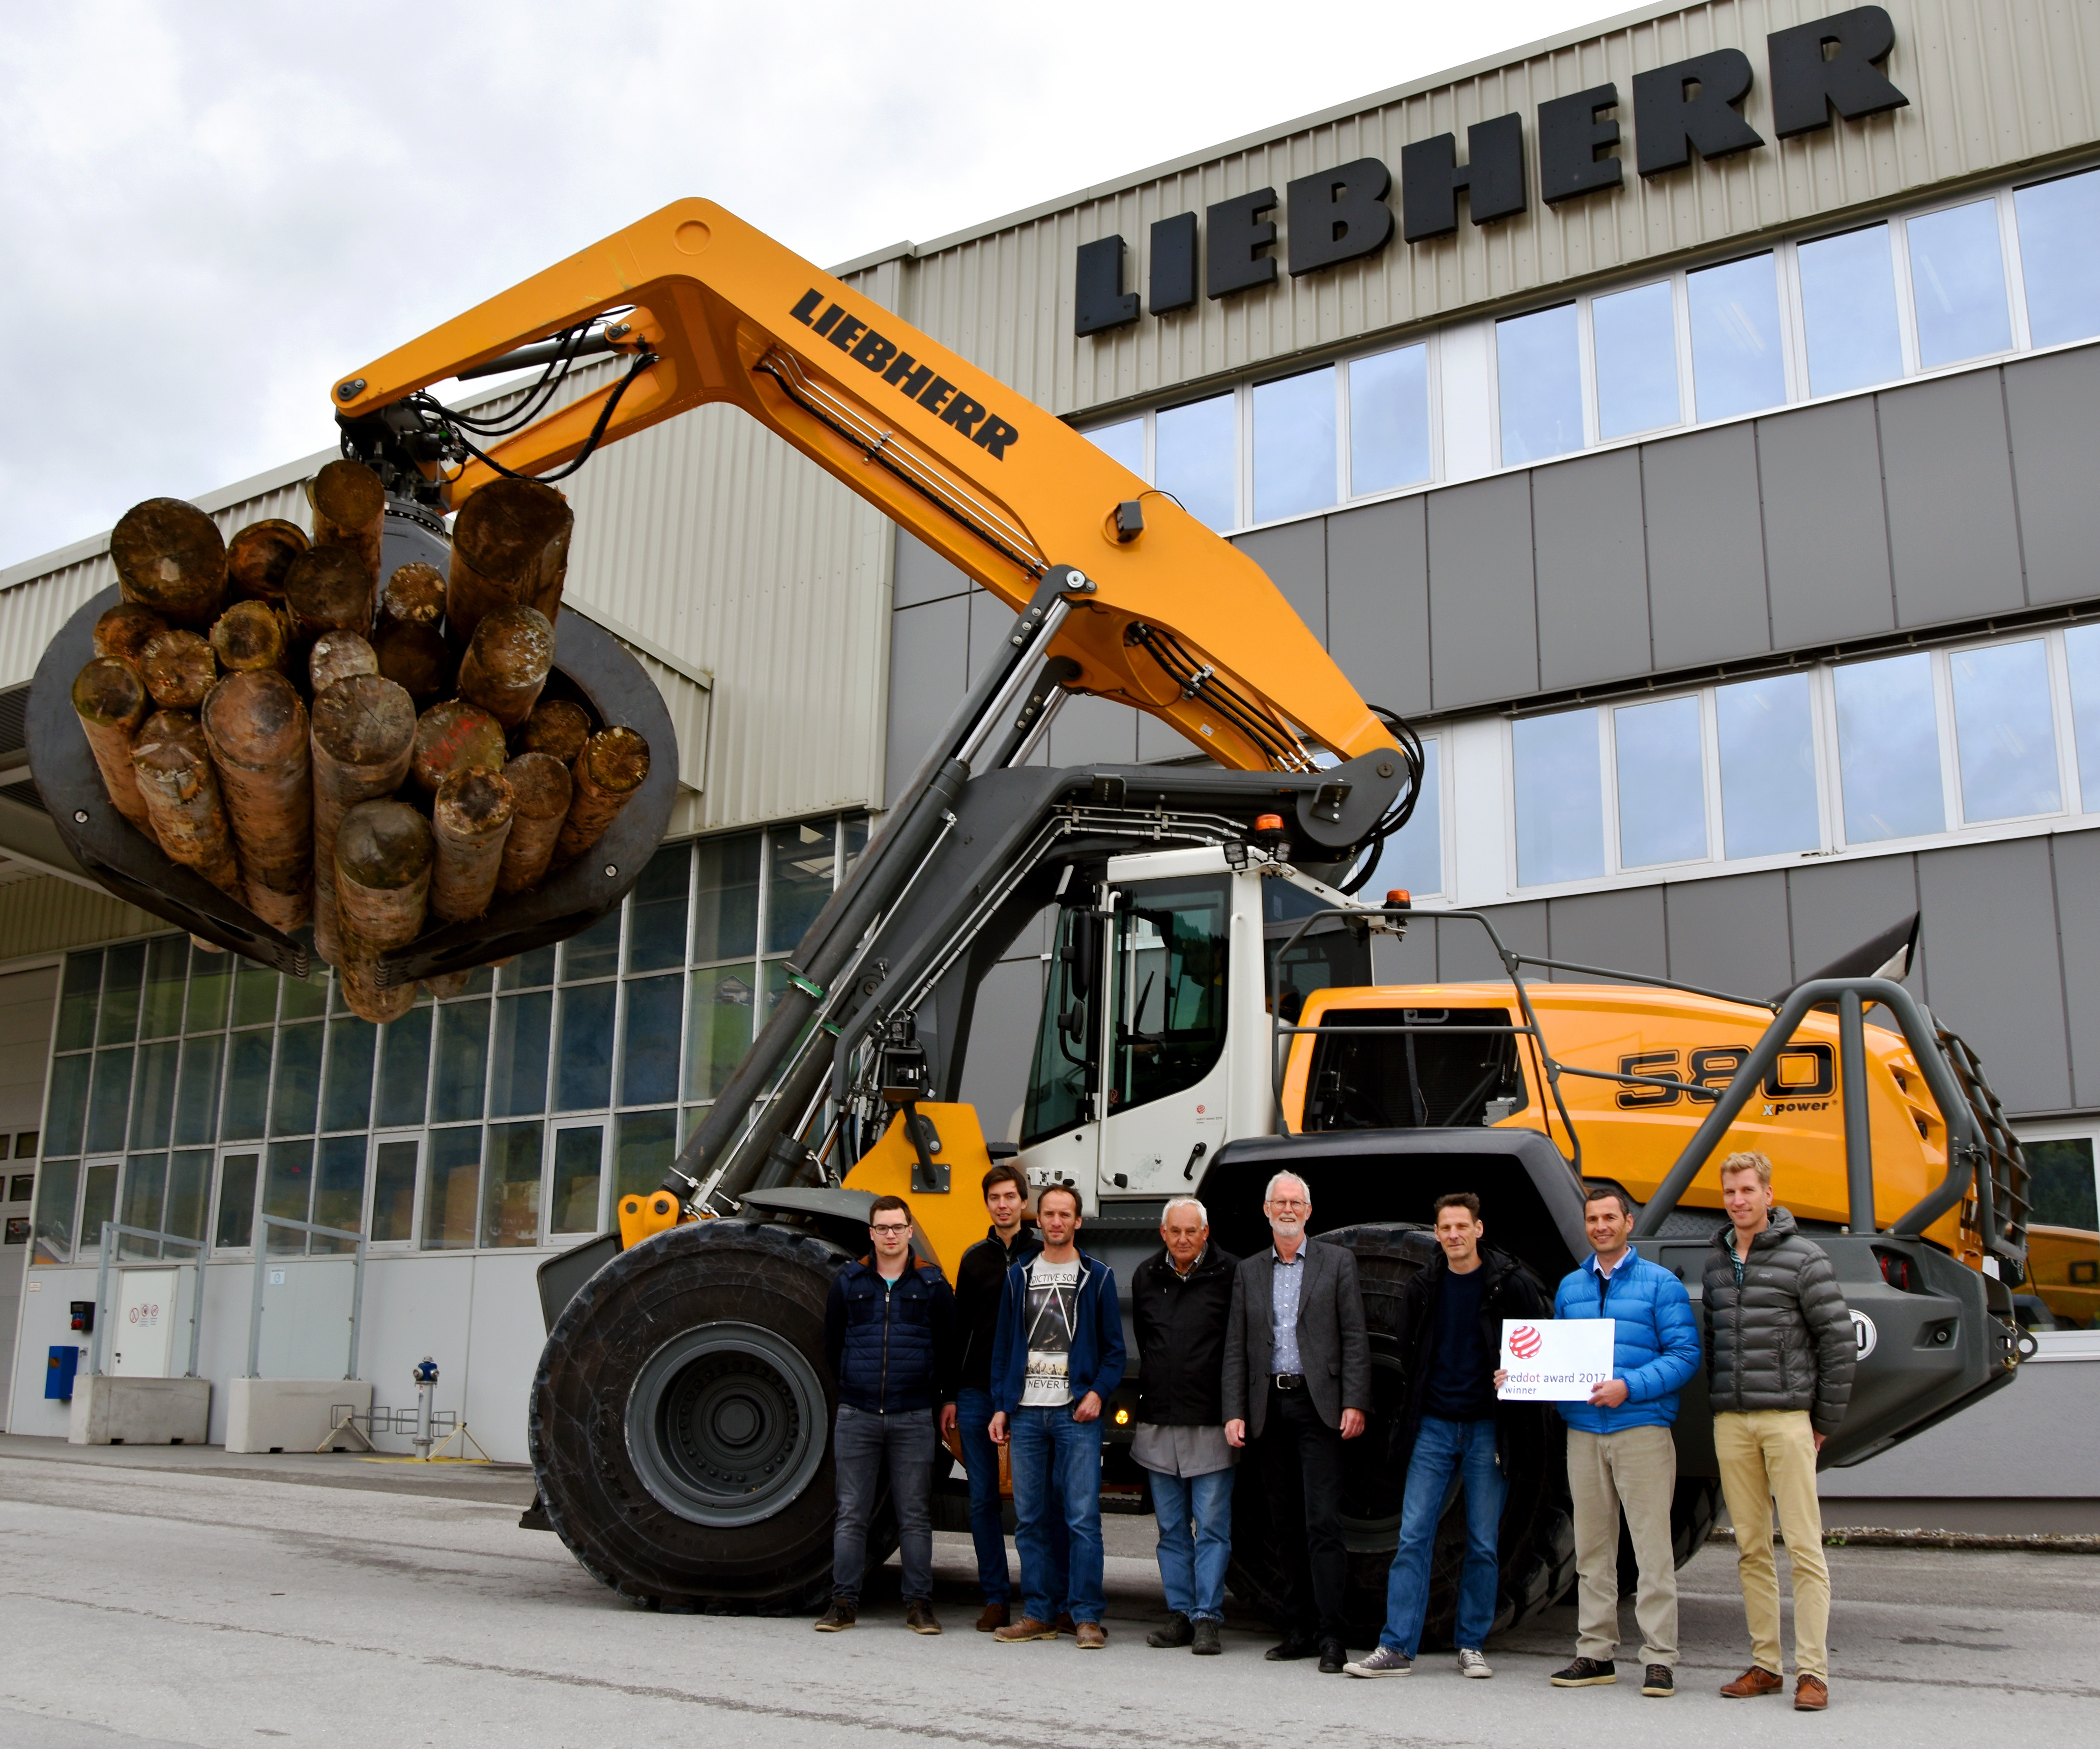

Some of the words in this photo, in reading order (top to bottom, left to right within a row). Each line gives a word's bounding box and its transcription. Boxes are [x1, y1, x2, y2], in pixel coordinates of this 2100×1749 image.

[1075, 5, 1910, 337] LIEBHERR
[789, 288, 1018, 462] LIEBHERR
[1616, 1042, 1837, 1110] 580
[1030, 1273, 1060, 1284] DICTIVE
[1062, 1273, 1078, 1282] SOU
[1506, 1372, 1540, 1382] reddot
[1544, 1372, 1575, 1383] award
[1579, 1373, 1606, 1383] 2017
[1028, 1380, 1059, 1389] NEVER
[1505, 1385, 1537, 1394] winner
